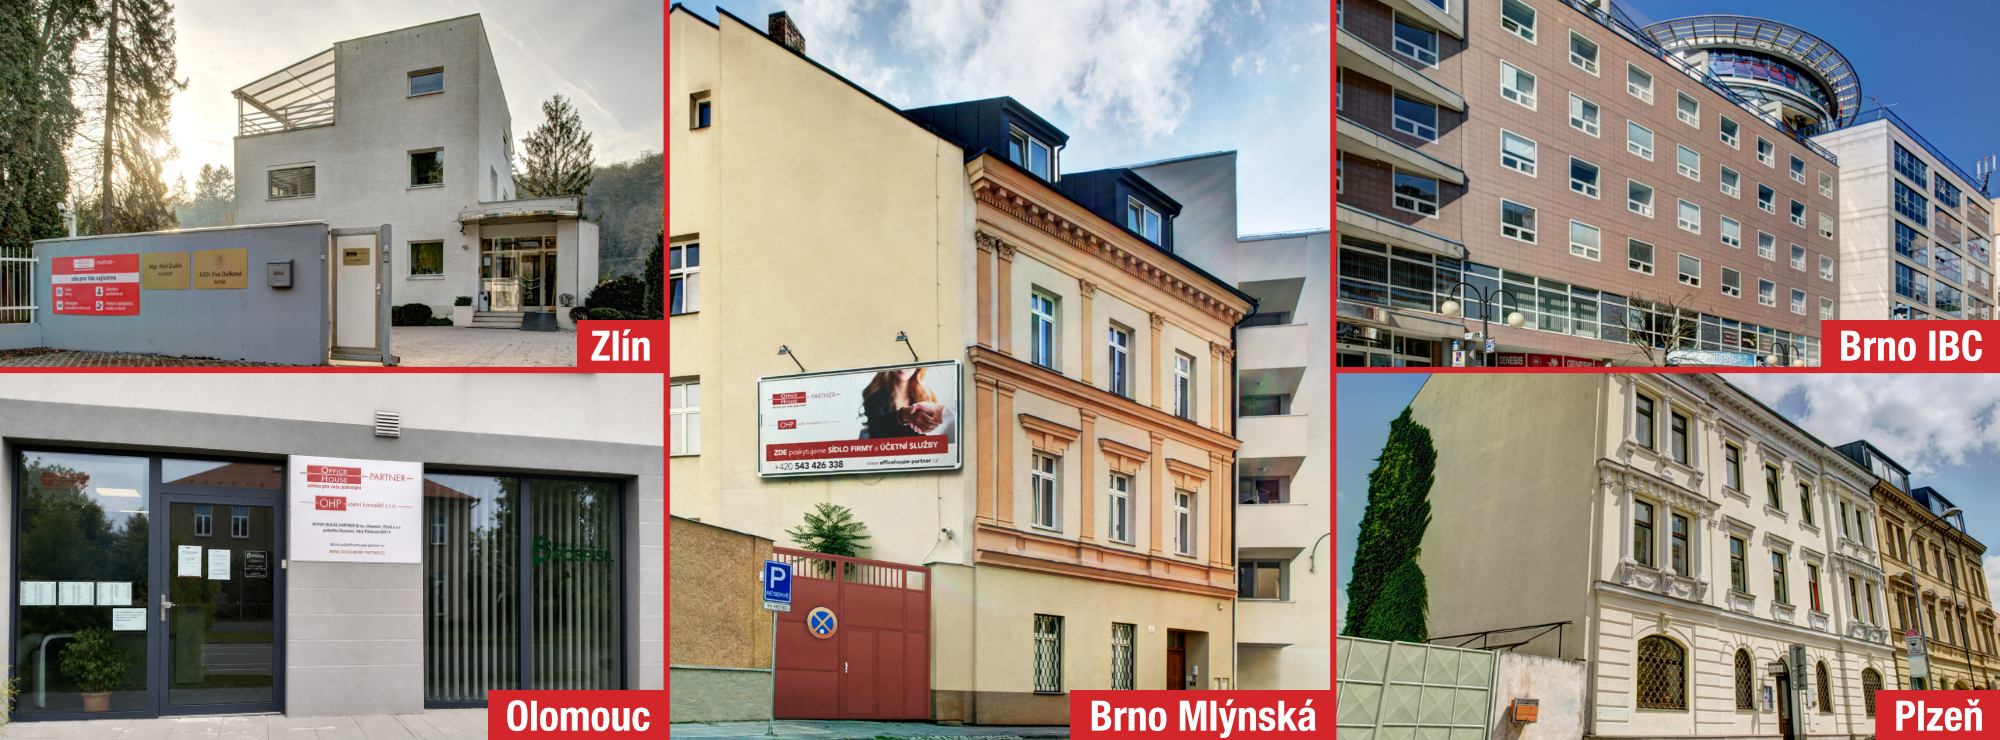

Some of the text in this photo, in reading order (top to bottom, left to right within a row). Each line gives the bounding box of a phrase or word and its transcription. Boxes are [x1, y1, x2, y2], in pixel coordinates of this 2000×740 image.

[1499, 356, 1523, 365] GENESIS
[1721, 354, 1748, 364] PASÁŽ
[788, 448, 826, 457] poskytujeme
[828, 445, 849, 453] SÍDLO
[880, 441, 908, 450] ÚČETNÍ
[909, 440, 938, 449] SLUŽBY
[812, 461, 826, 469] 426
[321, 466, 348, 475] OFFICE
[370, 473, 405, 482] PARTNER
[320, 498, 341, 508] OHP
[770, 566, 786, 588] P
